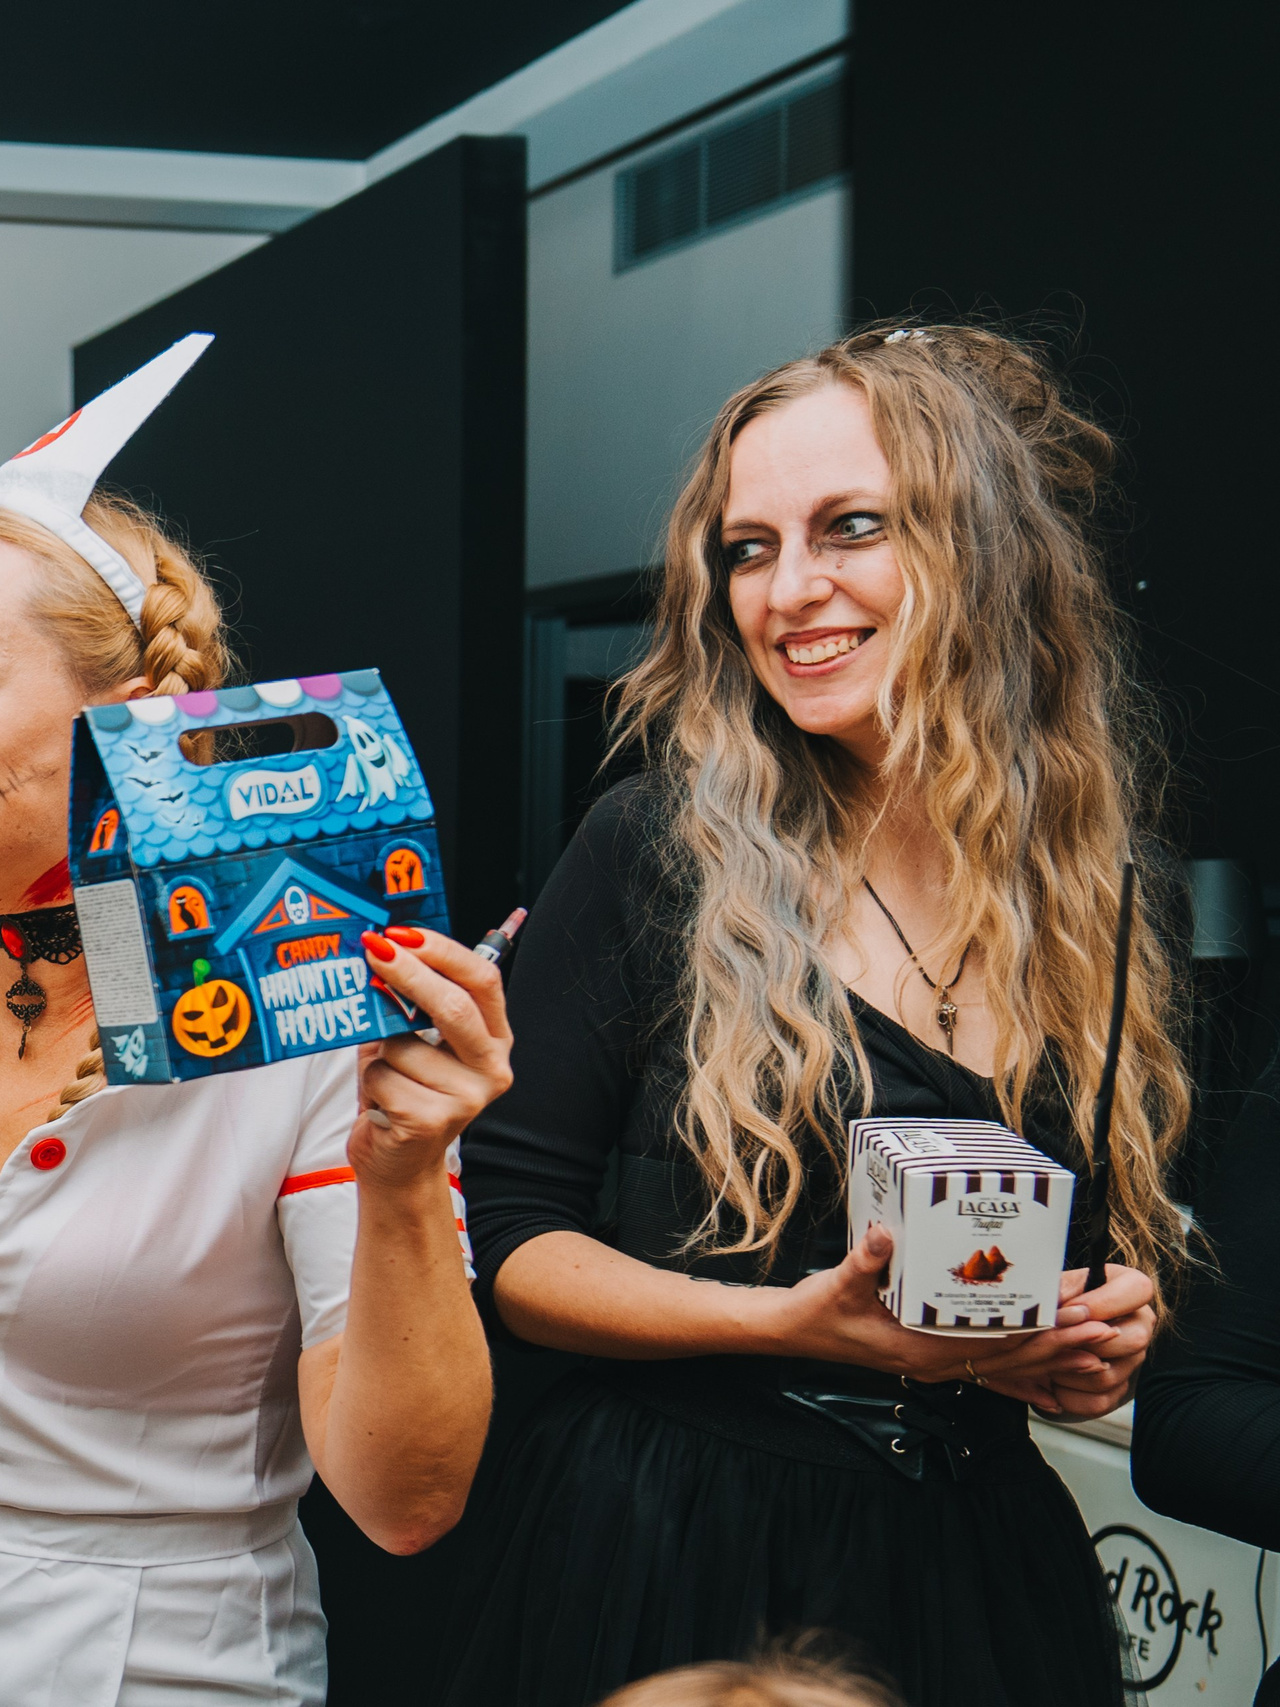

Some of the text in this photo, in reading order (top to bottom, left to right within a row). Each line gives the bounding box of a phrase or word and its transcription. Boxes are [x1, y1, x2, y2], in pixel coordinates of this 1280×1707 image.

[237, 778, 314, 807] VIDAL
[276, 933, 341, 970] CANDY
[259, 957, 368, 1010] HAUNTED
[275, 993, 371, 1046] HOUSE
[957, 1199, 1021, 1219] LACASA
[1131, 1564, 1223, 1656] Rock
